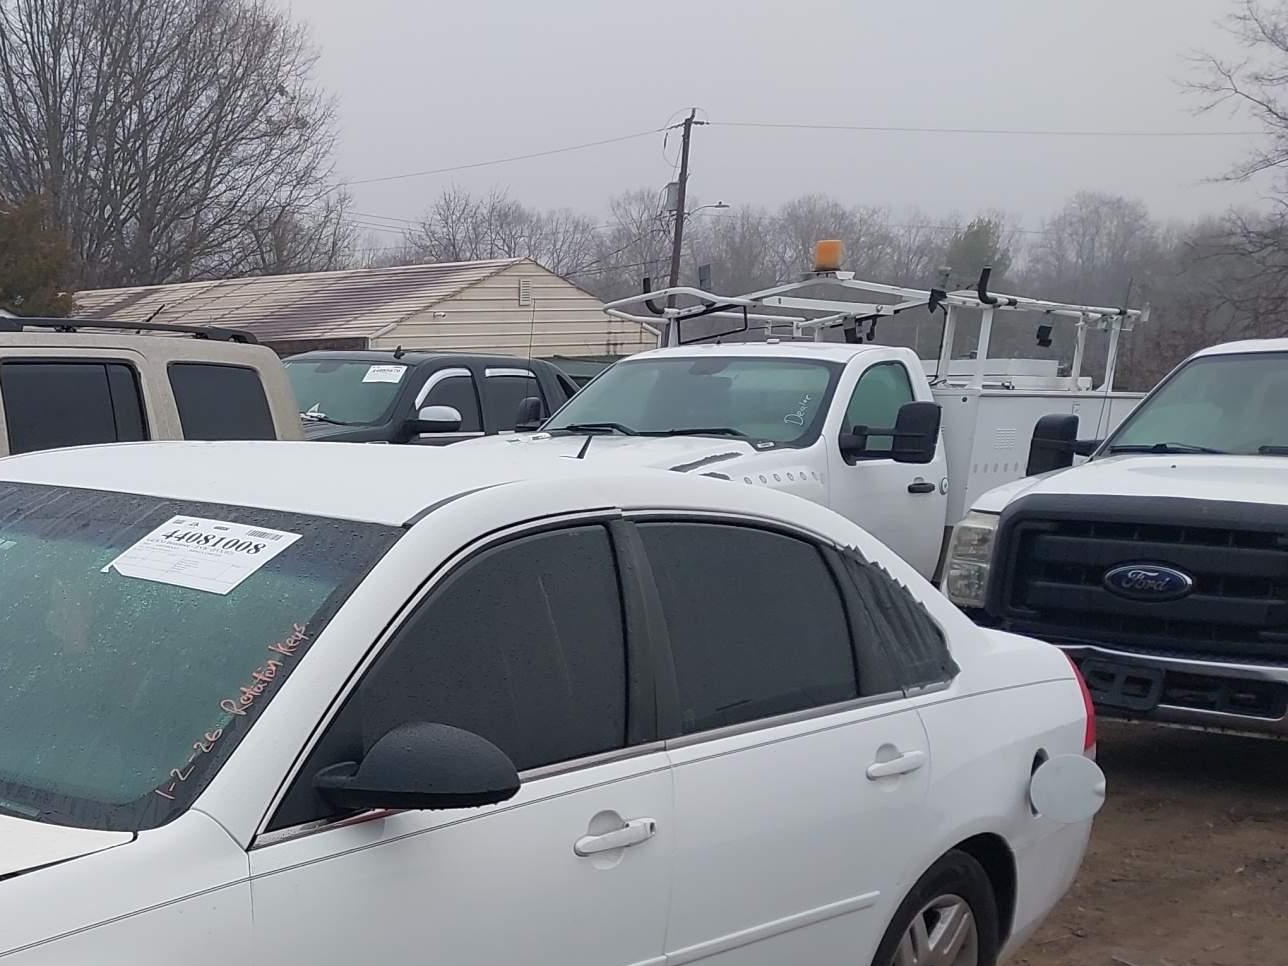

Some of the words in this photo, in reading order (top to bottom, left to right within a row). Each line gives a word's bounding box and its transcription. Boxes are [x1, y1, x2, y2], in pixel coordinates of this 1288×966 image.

[161, 529, 267, 555] 44081008
[1121, 569, 1171, 591] Ford
[268, 622, 310, 657] Keys
